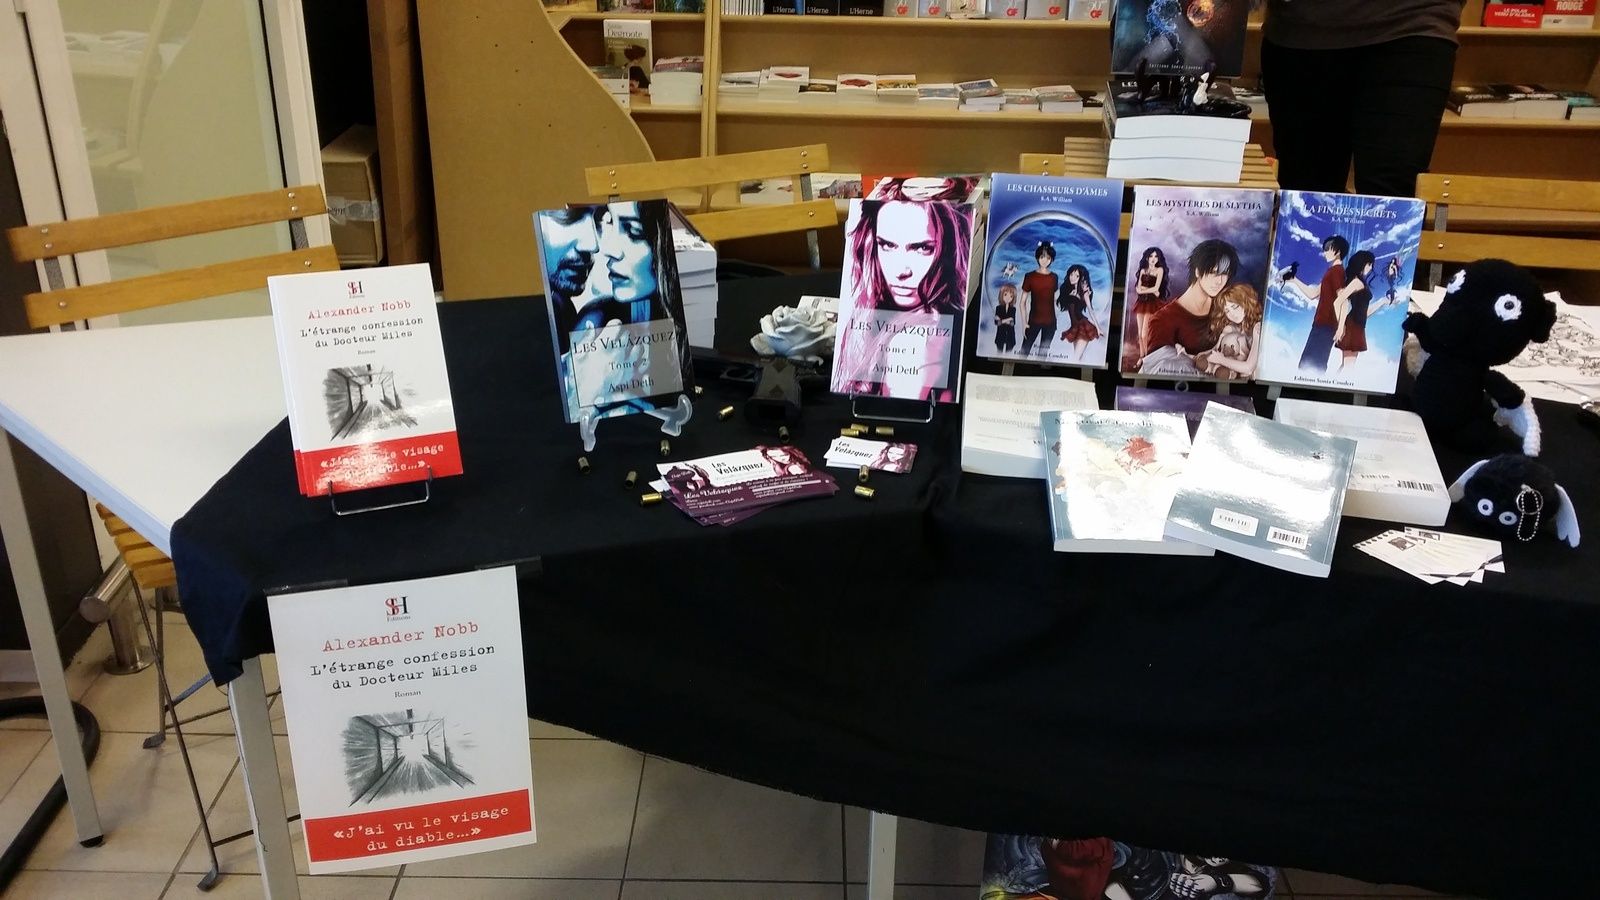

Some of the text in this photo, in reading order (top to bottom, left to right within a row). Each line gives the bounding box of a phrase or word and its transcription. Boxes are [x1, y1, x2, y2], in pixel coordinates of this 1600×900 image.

[1556, 1, 1584, 10] ROUGE
[1007, 183, 1022, 192] LES
[1023, 184, 1074, 194] CHASSEURS
[1146, 199, 1162, 207] LES
[1212, 201, 1224, 210] DE
[1224, 200, 1262, 210] SLYTHA
[1304, 204, 1398, 219] LA FIN DES SECRETS
[308, 300, 412, 320] Alexander Nobb
[300, 316, 424, 338] L'étrange confession
[850, 318, 950, 338] LES VELÁZQUEZ
[314, 330, 413, 349] du Docteur Miles
[574, 330, 676, 354] LES VELÁZQUEZ
[878, 344, 916, 355] Tome 1
[608, 358, 648, 370] Tome 2
[872, 364, 920, 376] Aspi Deth
[608, 378, 655, 394] Aspi Deth
[402, 444, 444, 457] visage
[322, 621, 480, 652] Alexander Nobb
[310, 644, 496, 677] L'étrange confession
[332, 662, 478, 691] du Docteur Miles
[394, 690, 422, 698] Roman
[333, 806, 509, 840] «J'ai vu le visage
[366, 840, 388, 852] du
